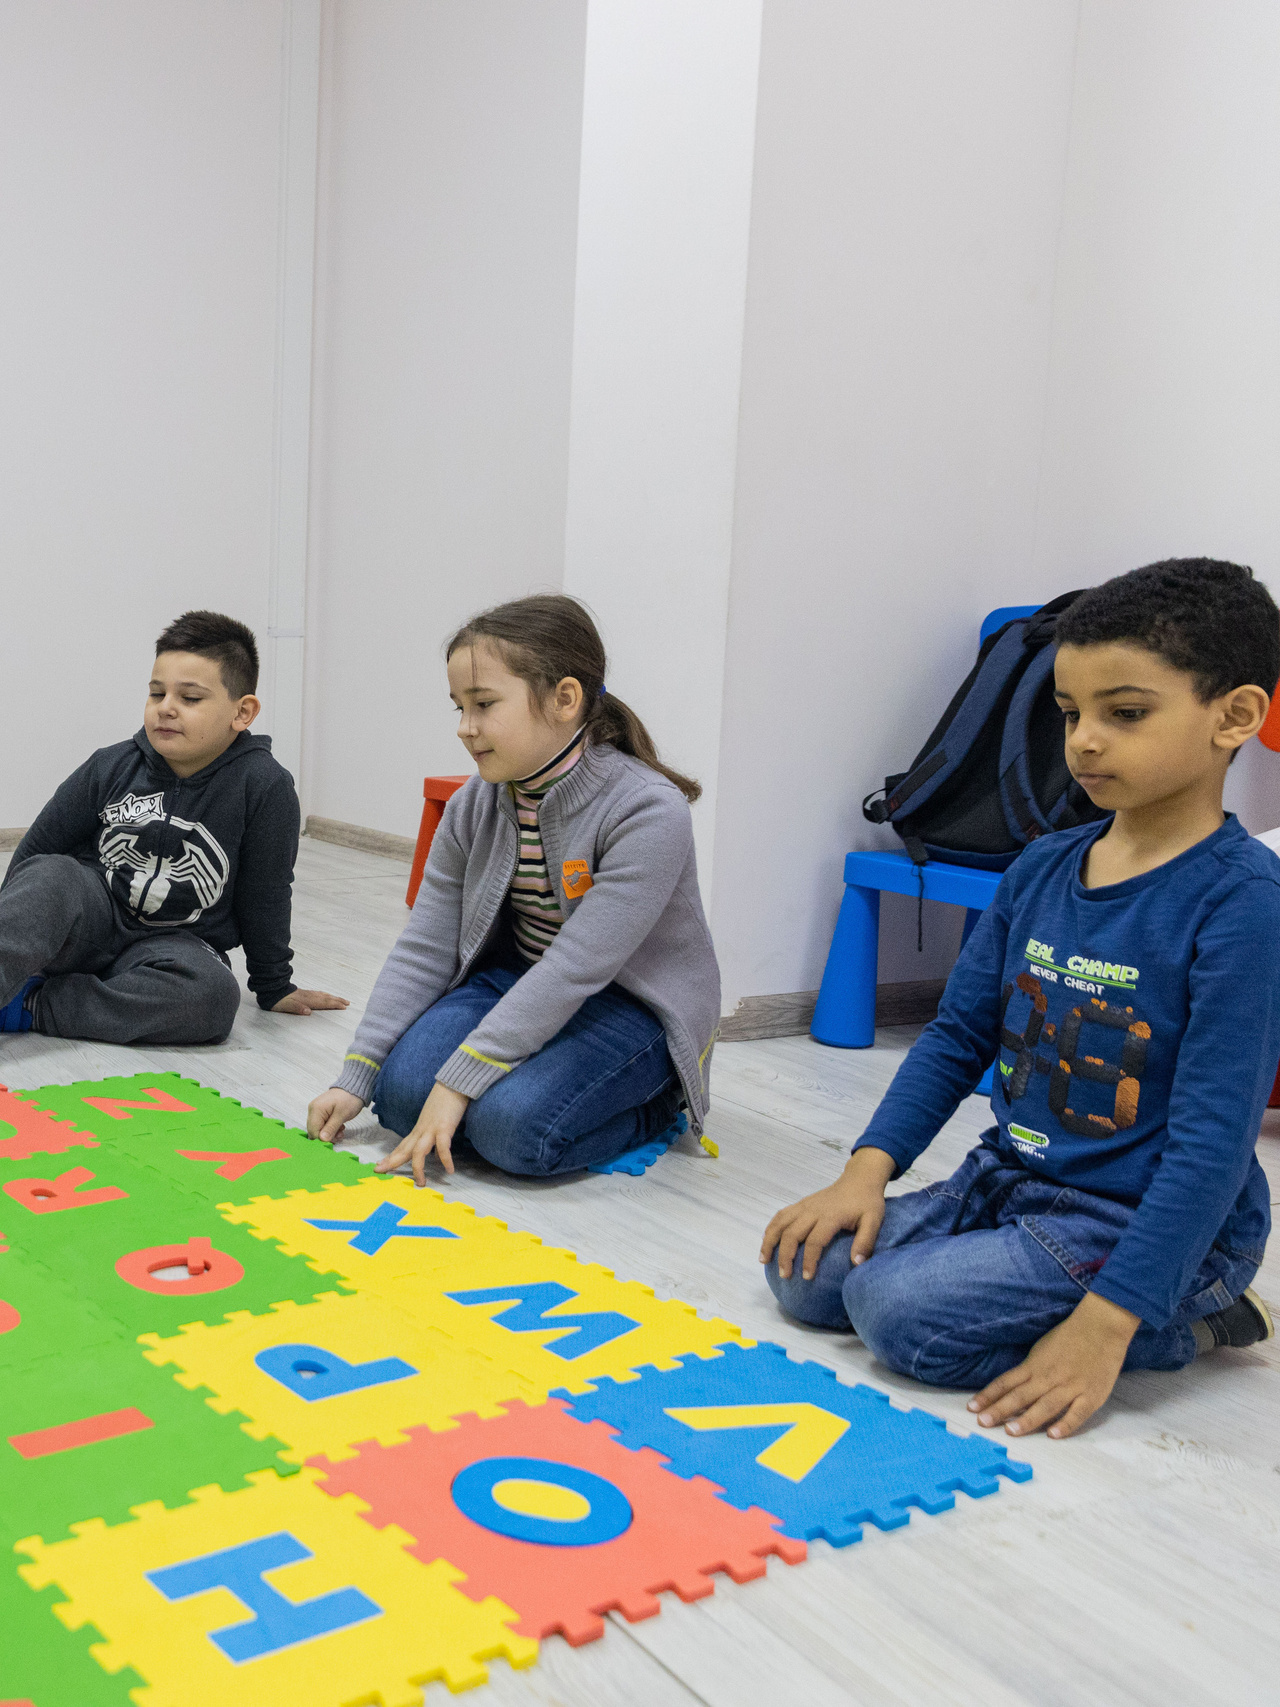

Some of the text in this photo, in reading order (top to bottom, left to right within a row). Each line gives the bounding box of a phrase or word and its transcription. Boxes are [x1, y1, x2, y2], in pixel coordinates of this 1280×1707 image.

[1030, 963, 1105, 995] NEVER CHEAT
[1067, 955, 1139, 982] CHAMP
[80, 1086, 198, 1120] Z
[1, 1165, 131, 1215] R
[174, 1147, 293, 1182] Y
[302, 1201, 460, 1257] X
[114, 1236, 246, 1296] Q
[443, 1280, 643, 1362] W
[253, 1342, 420, 1403] P
[662, 1402, 852, 1483] V
[450, 1455, 635, 1548] O
[144, 1530, 385, 1665] H
